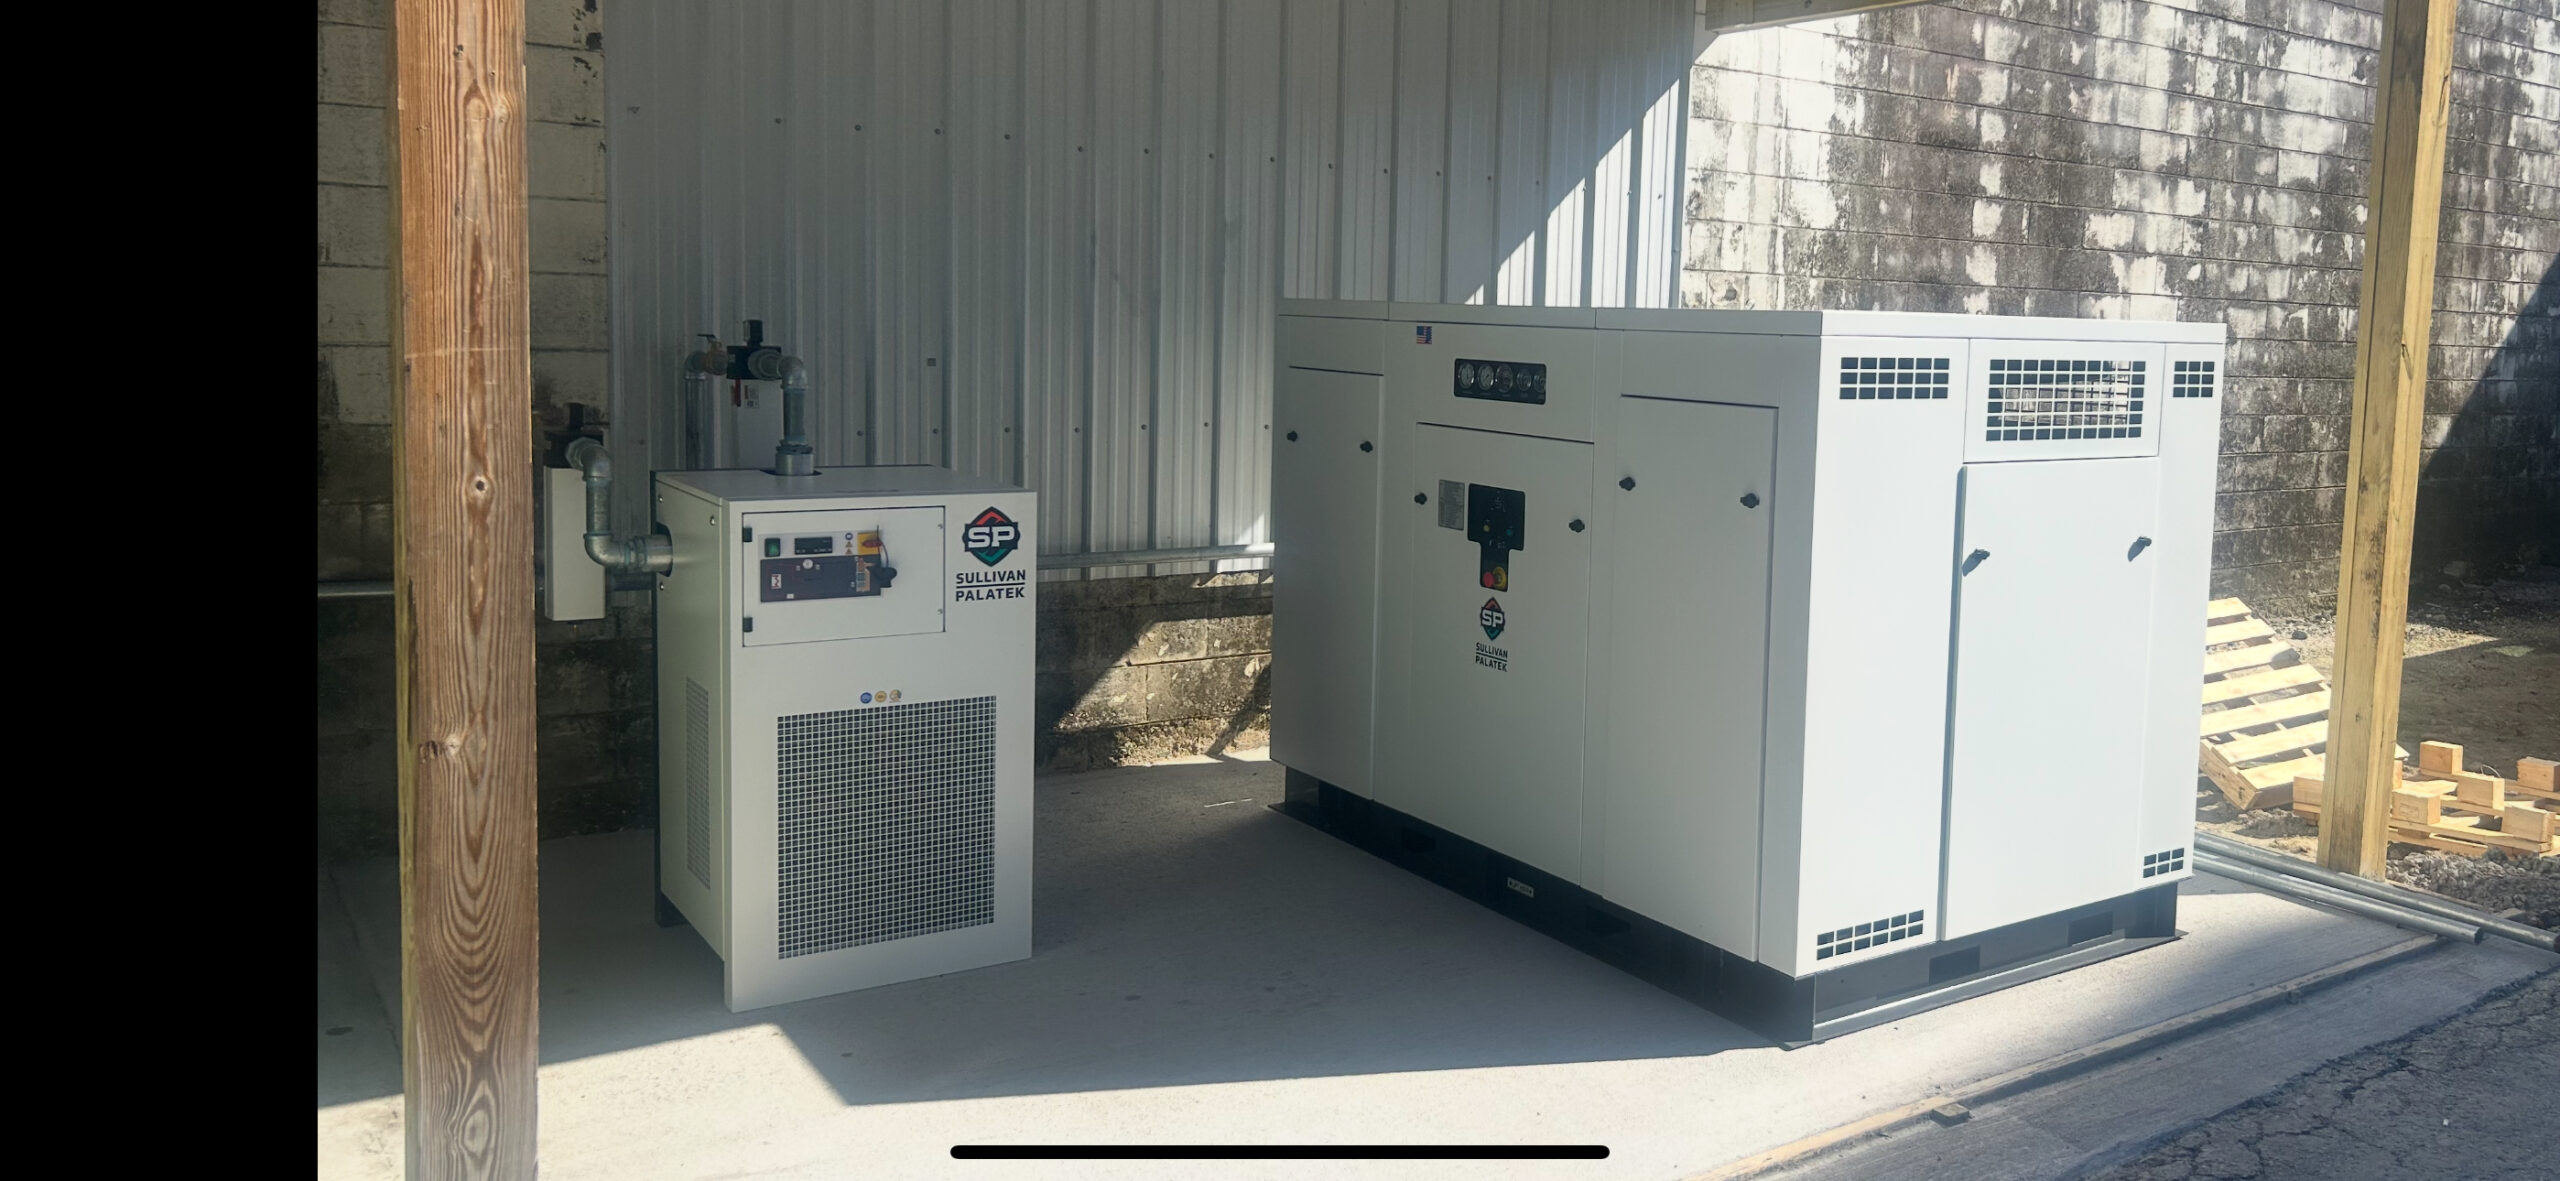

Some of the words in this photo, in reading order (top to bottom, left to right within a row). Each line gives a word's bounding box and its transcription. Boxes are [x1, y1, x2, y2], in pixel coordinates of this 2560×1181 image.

[968, 526, 1015, 548] SP
[956, 569, 1026, 584] SULLIVAN
[955, 586, 1025, 602] PALATEK
[1481, 609, 1503, 627] SP
[1475, 642, 1508, 659] SULLIVAN
[1475, 655, 1507, 672] PALATEK
